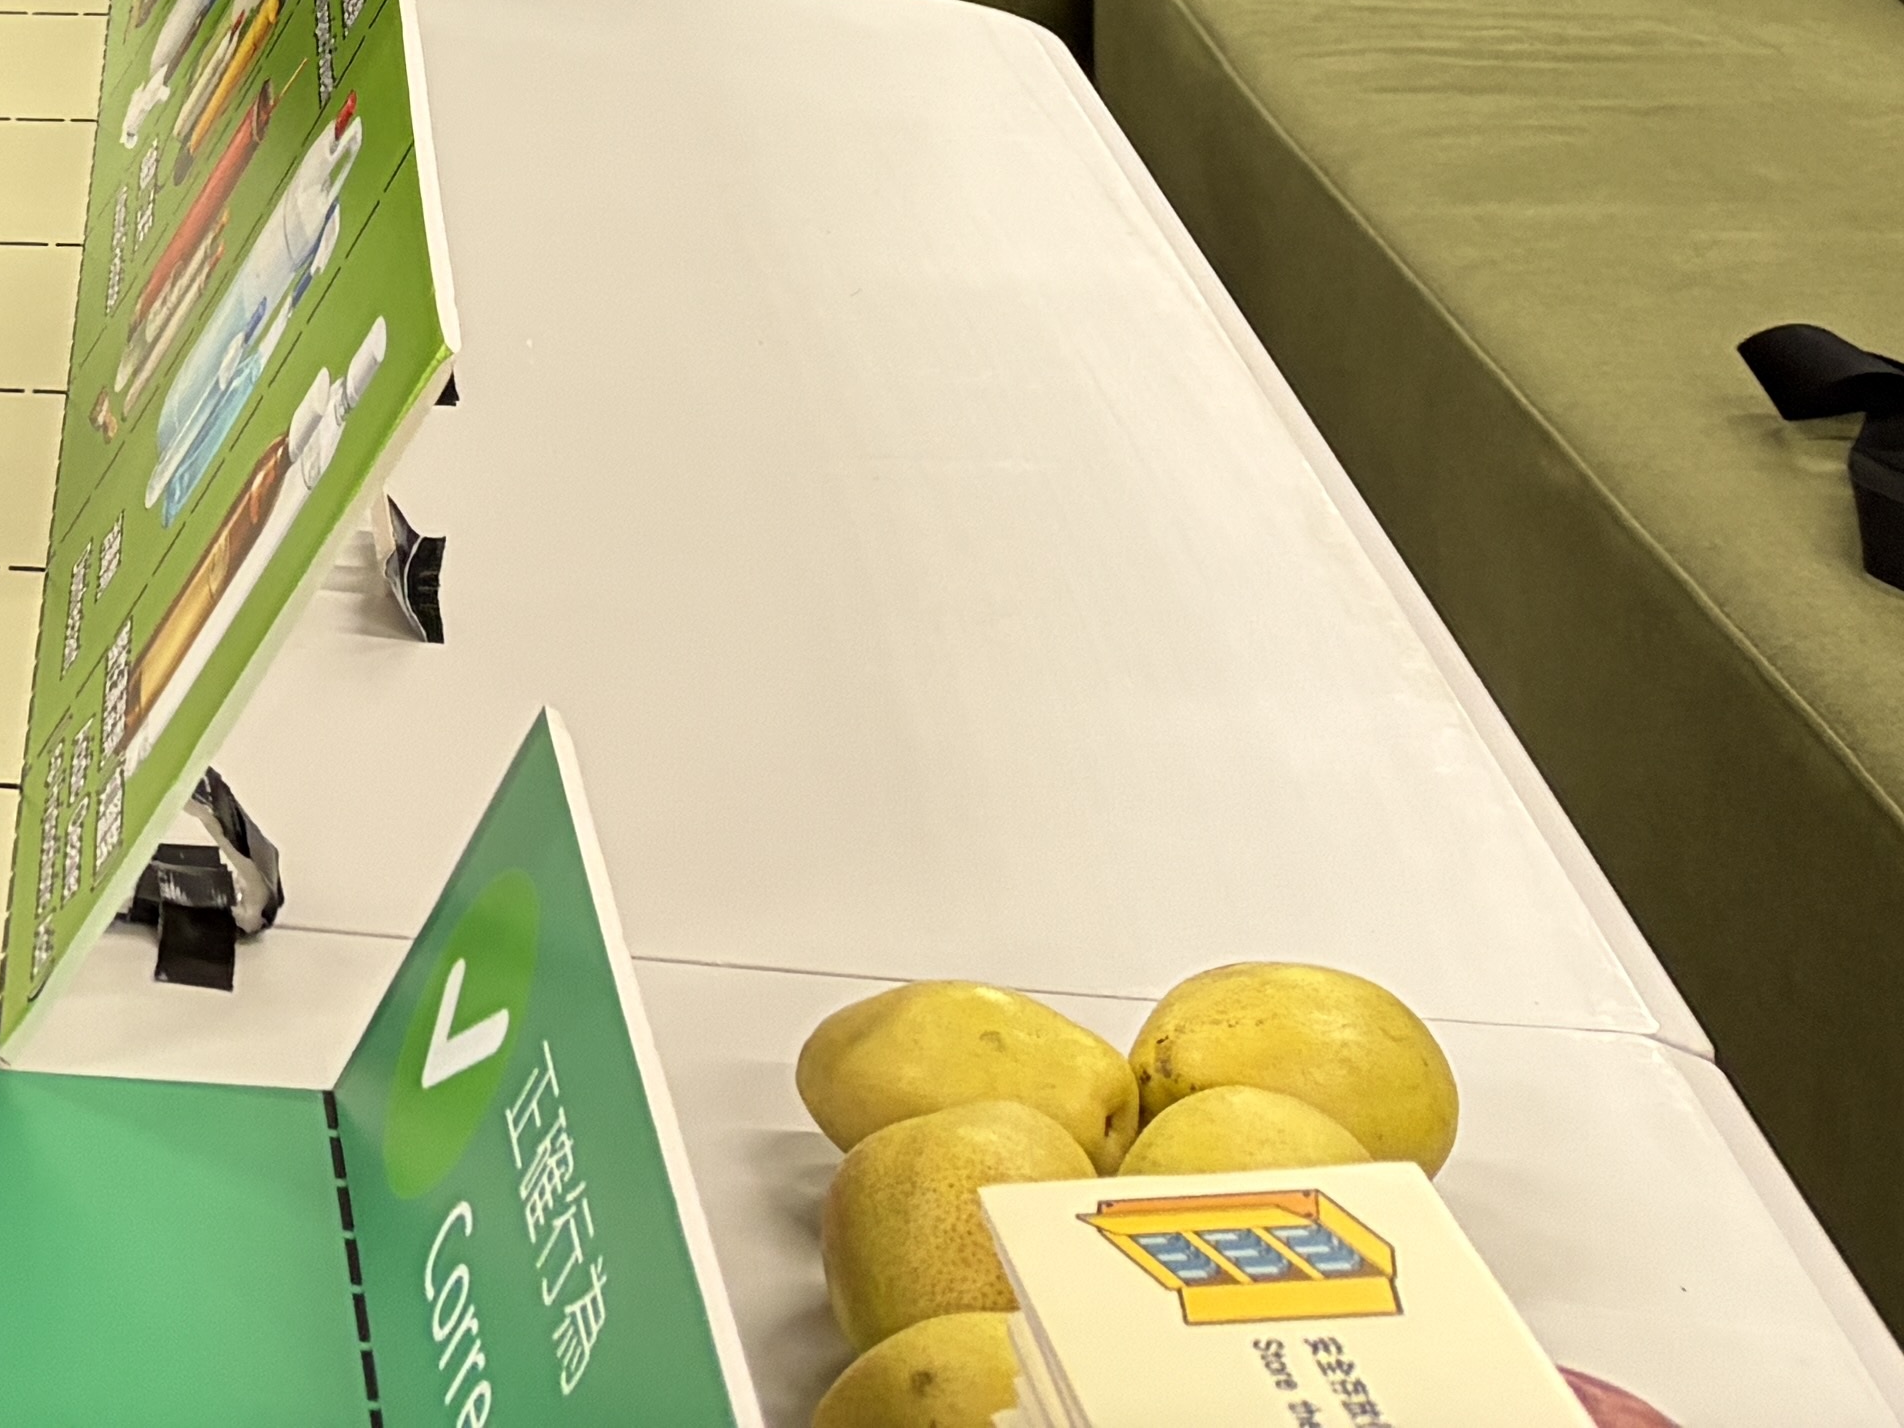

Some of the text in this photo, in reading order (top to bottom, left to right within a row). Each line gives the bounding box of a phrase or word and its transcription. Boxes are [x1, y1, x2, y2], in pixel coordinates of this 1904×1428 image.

[504, 1039, 608, 1396] 正確行為
[1252, 1338, 1298, 1392] Store
